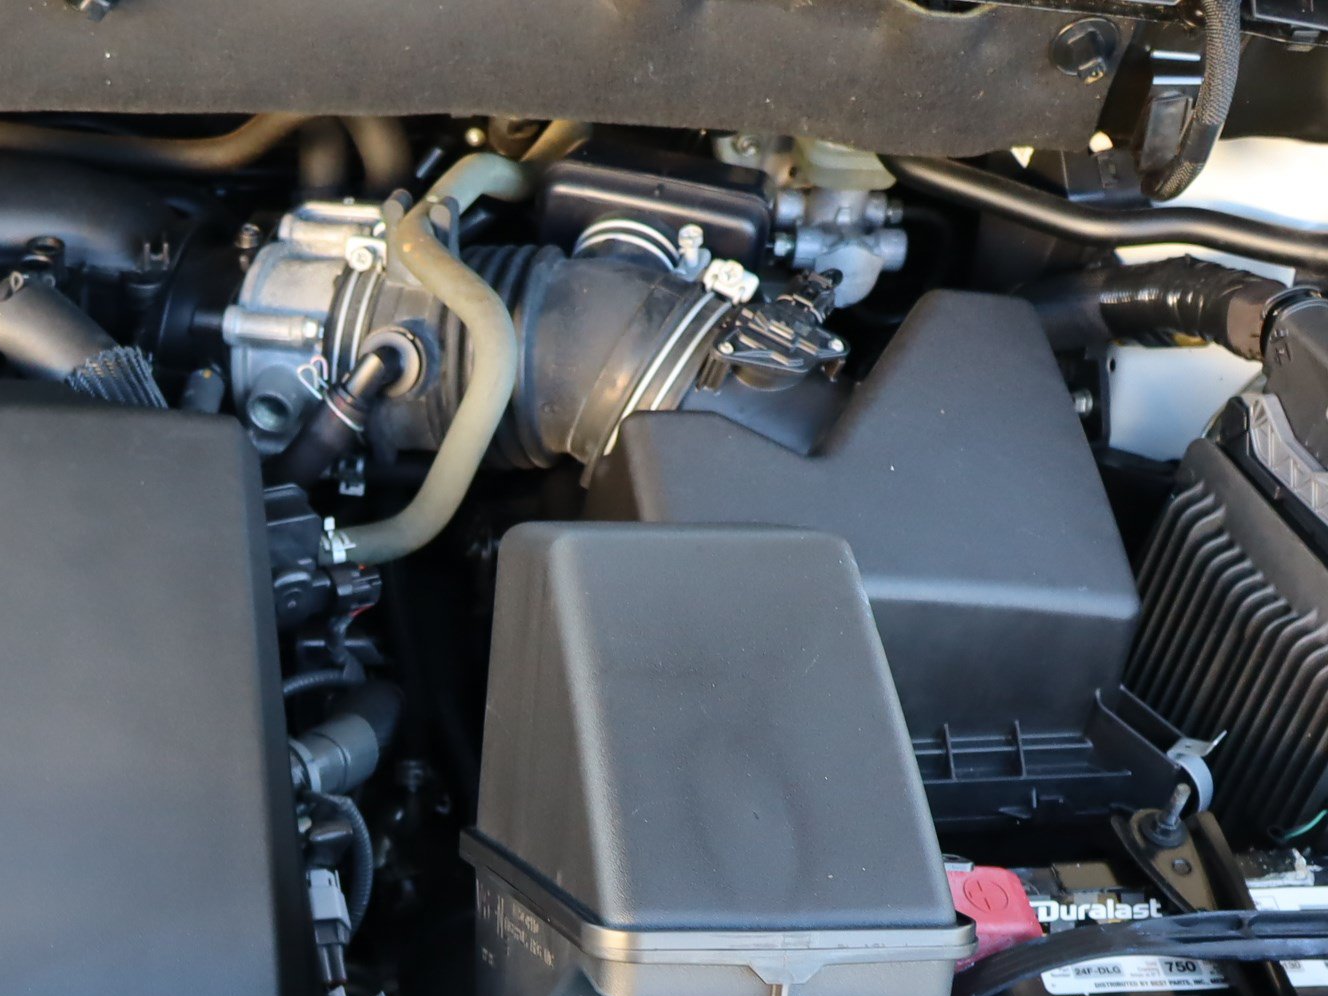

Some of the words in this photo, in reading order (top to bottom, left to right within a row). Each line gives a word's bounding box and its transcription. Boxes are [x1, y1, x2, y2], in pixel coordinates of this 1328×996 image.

[1030, 898, 1162, 922] Duralast
[1074, 965, 1122, 976] 24F-DLG
[1165, 960, 1197, 973] 750
